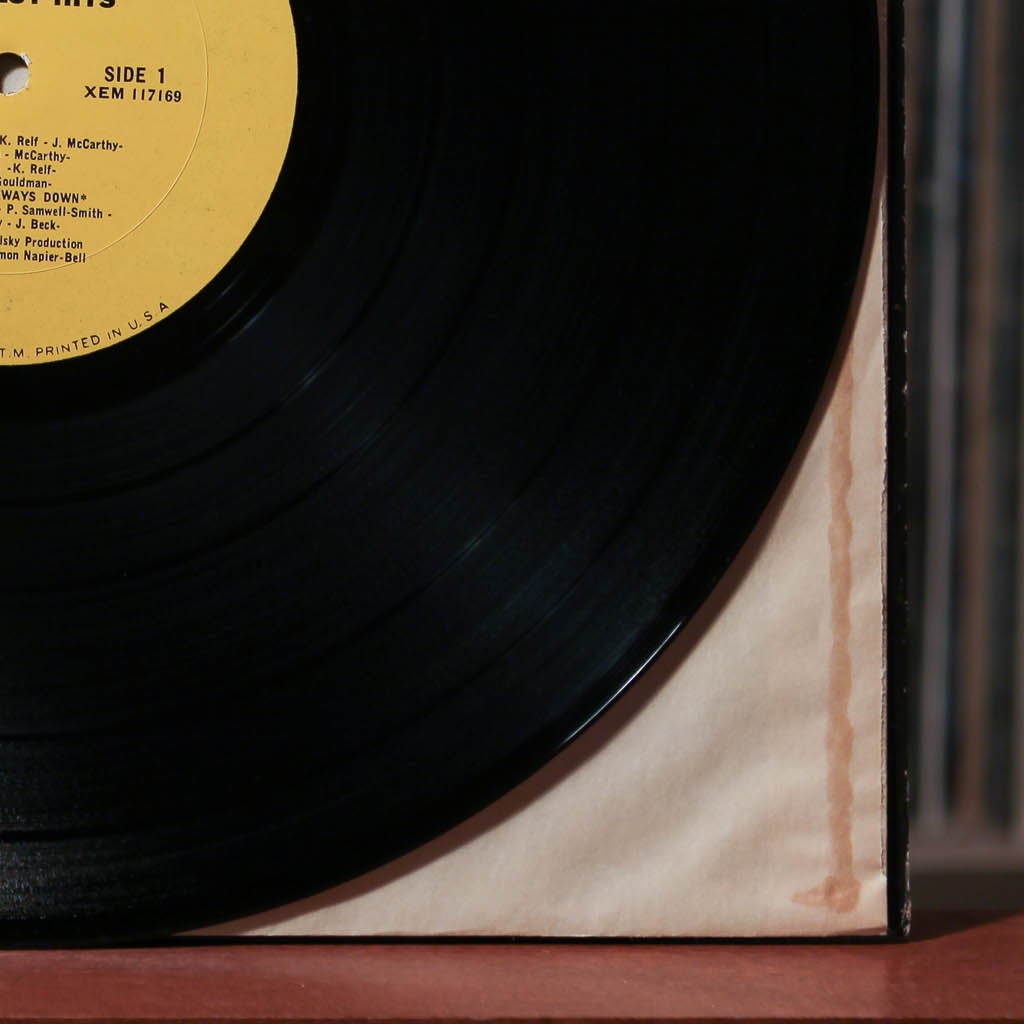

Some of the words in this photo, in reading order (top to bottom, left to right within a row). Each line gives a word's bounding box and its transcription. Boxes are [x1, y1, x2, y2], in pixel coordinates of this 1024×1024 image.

[104, 65, 147, 84] SIDE
[157, 67, 165, 84] 1
[83, 85, 126, 100] XEM
[132, 88, 182, 103] 117169
[0, 134, 11, 146] K.
[17, 135, 39, 147] Relf
[51, 137, 62, 148] J.
[6, 203, 18, 215] P.
[21, 204, 103, 219] Samwell-Smith
[15, 217, 26, 230] J.
[24, 236, 83, 250] Production
[23, 249, 86, 264] Napier-Bell
[35, 334, 101, 357] PRINTED
[106, 327, 123, 340] IN
